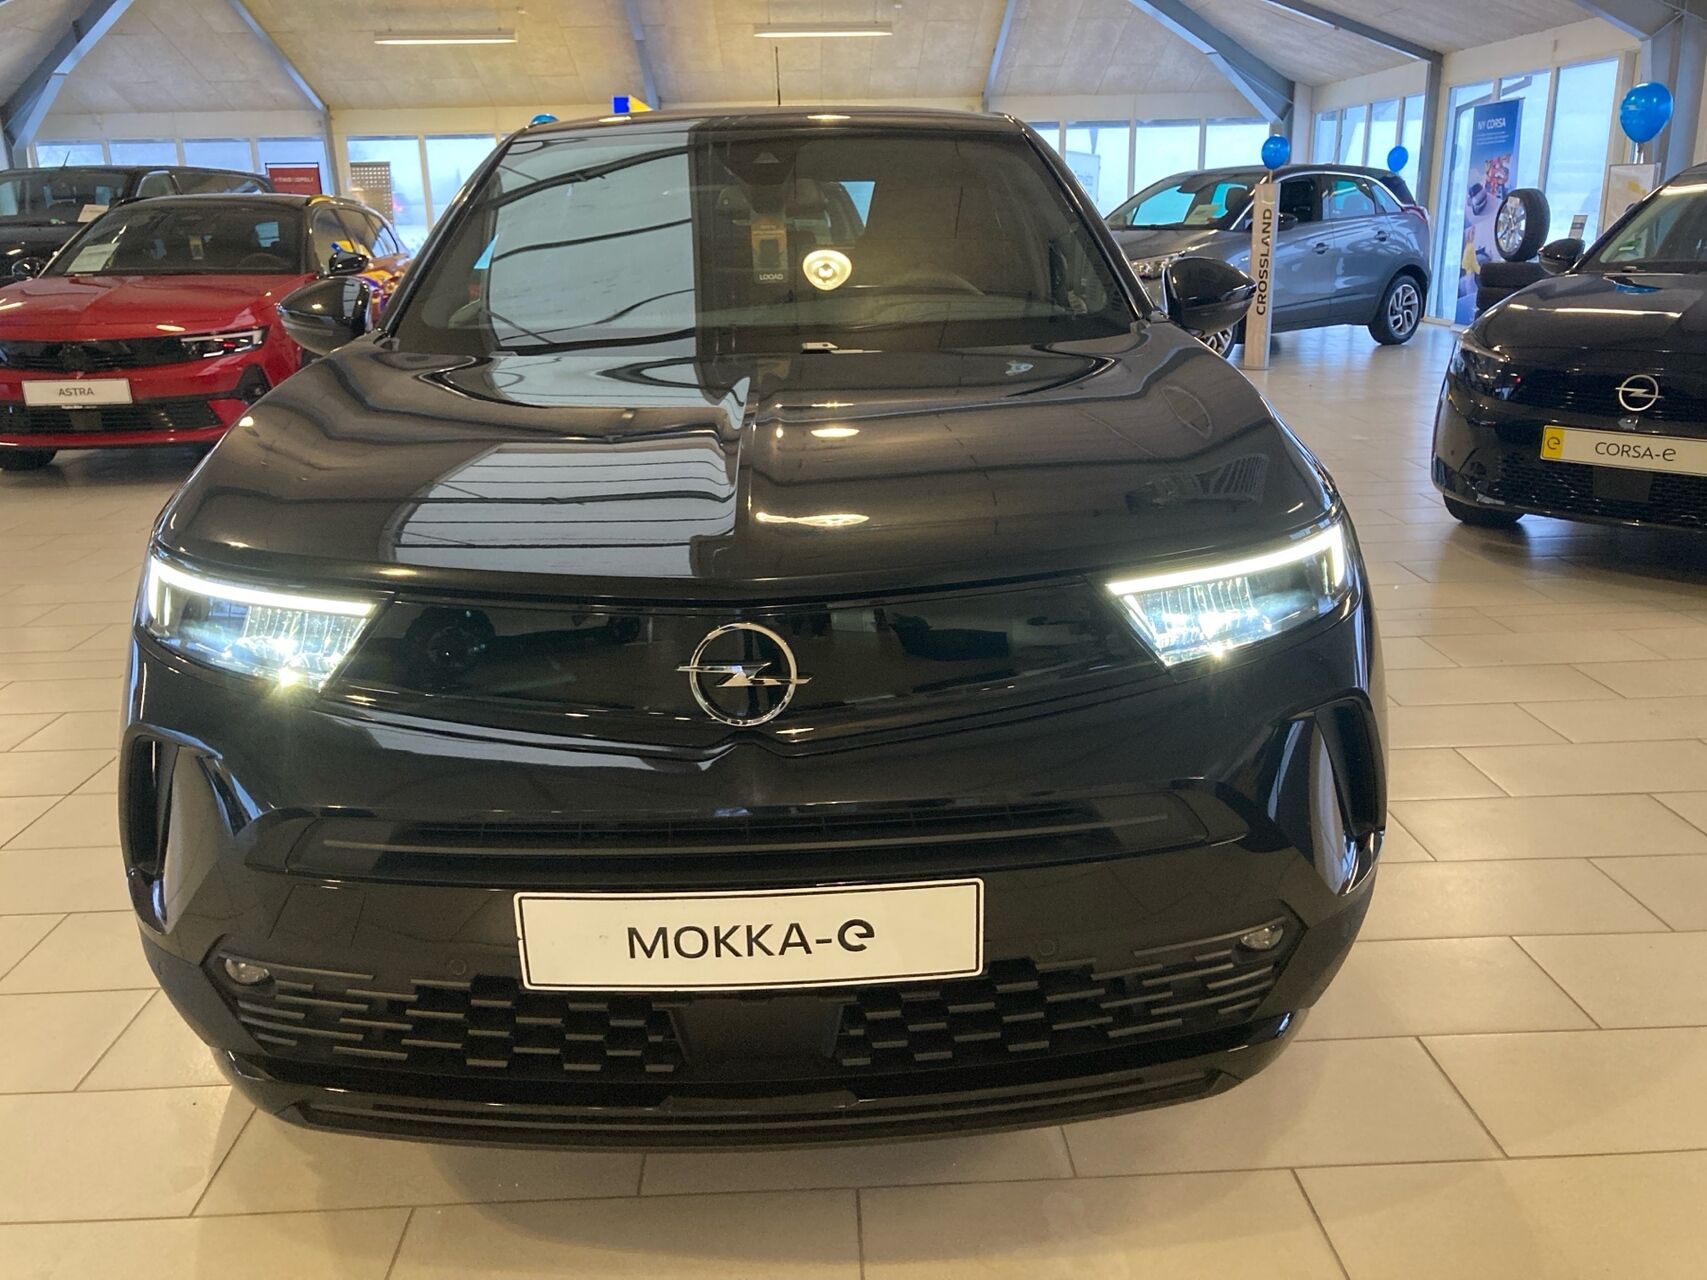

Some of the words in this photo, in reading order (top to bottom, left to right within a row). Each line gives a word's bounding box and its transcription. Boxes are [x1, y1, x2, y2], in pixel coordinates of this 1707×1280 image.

[1487, 117, 1506, 130] CORSA
[1256, 208, 1272, 316] CROSSLAND
[58, 387, 95, 397] ASTRA
[1595, 441, 1676, 462] CORSA-e
[626, 918, 876, 960] MOKKA-e
